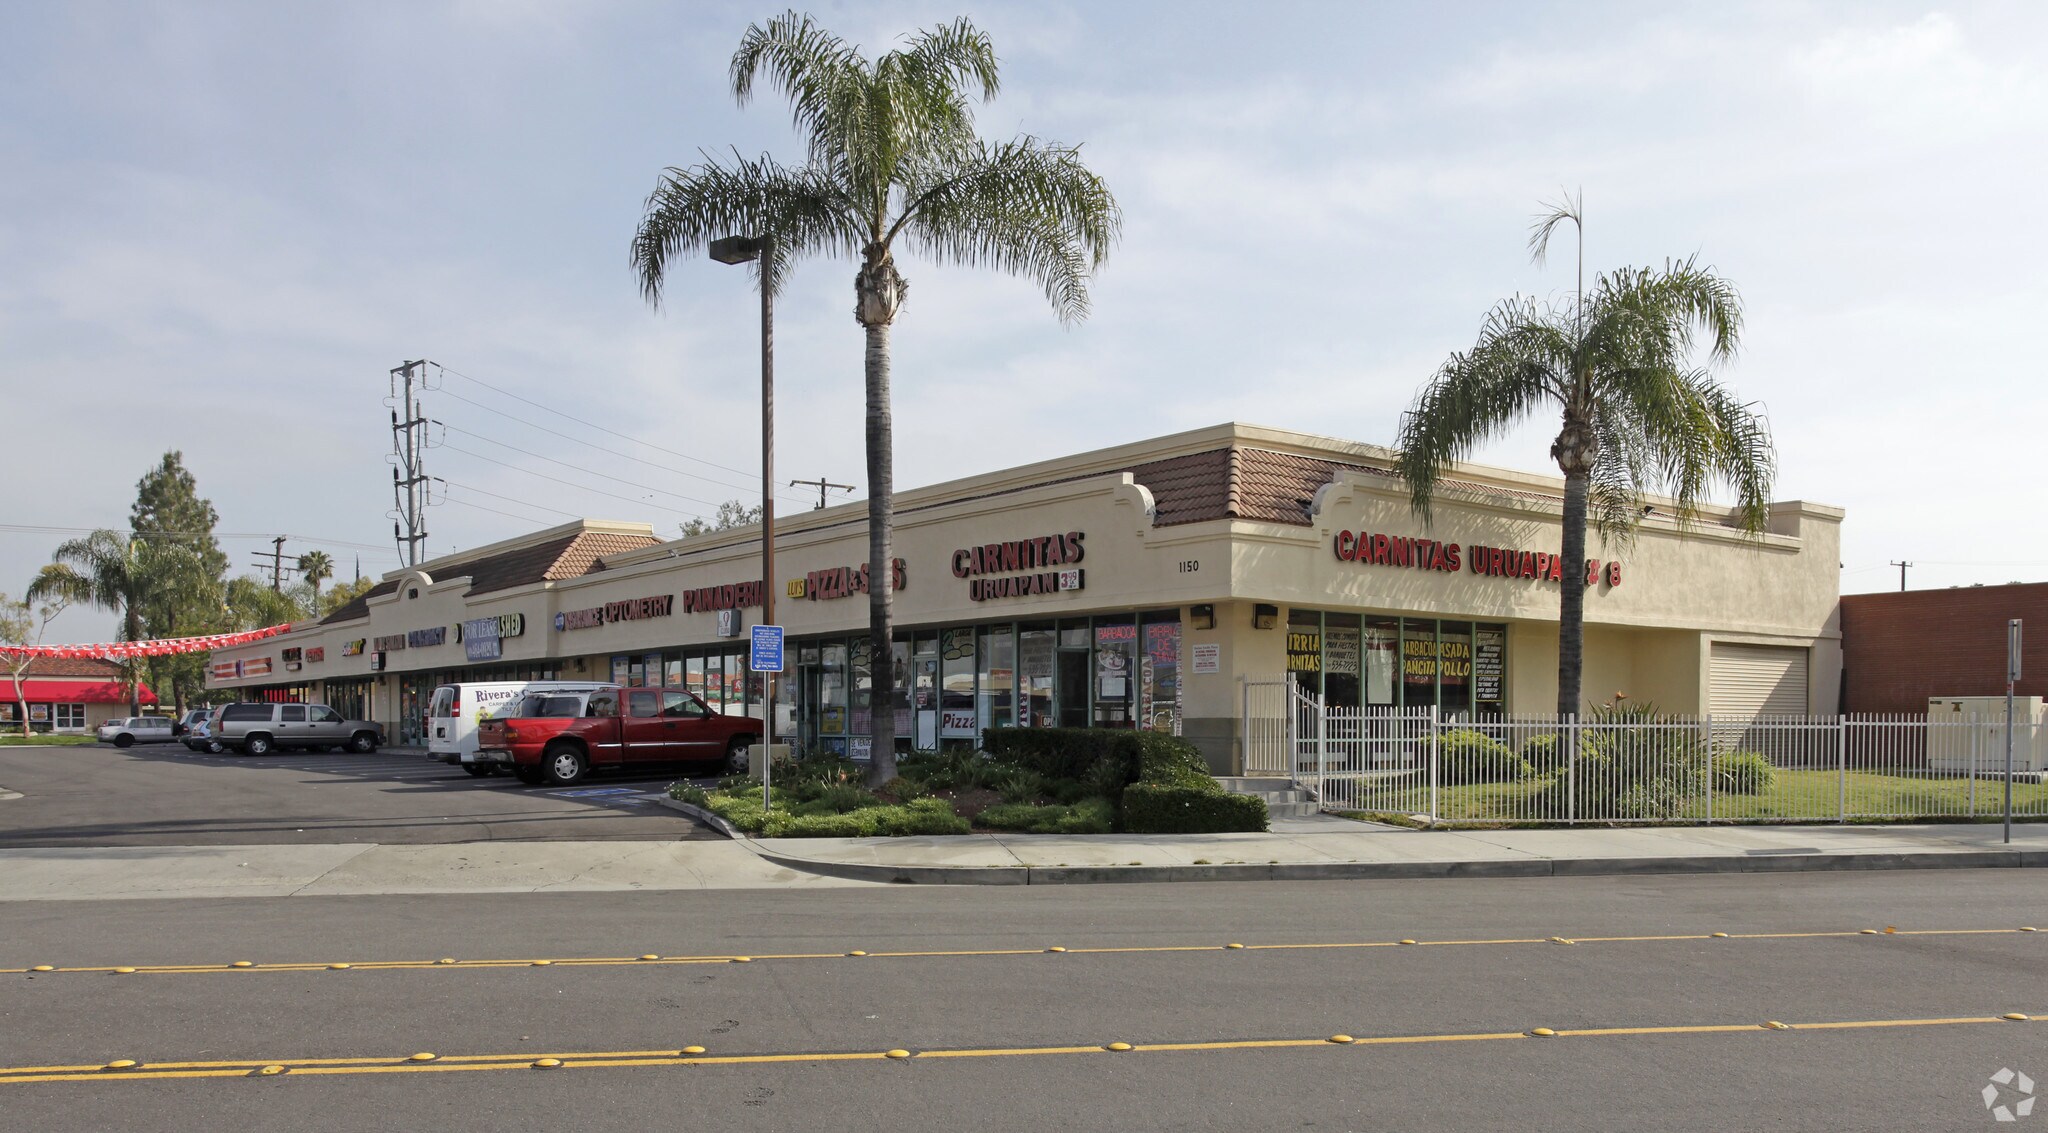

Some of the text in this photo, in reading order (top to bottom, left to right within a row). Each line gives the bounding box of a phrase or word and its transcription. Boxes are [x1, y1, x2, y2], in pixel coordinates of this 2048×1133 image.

[951, 531, 1085, 578] CARNITAS
[1334, 529, 1461, 572] CARNITAS
[1470, 545, 1563, 582] URUAPA
[1606, 560, 1621, 587] 8
[1179, 560, 1199, 573] 1150
[807, 567, 853, 601] PIZZA
[970, 572, 1059, 601] URUAPAN
[683, 581, 776, 613] PANADERI
[604, 595, 674, 623] OPTOMETRY
[479, 621, 498, 637] LEASE
[1158, 638, 1170, 651] DE
[1287, 633, 1320, 651] IRRIA
[1403, 640, 1437, 656] ARBACOA
[1440, 642, 1470, 658] ASADA
[1287, 654, 1320, 672] ARNITAS
[1403, 660, 1436, 675] PANCITA
[1440, 661, 1471, 676] POLLO
[475, 690, 519, 703] Rivera's
[1020, 675, 1029, 725] BIRRI
[1142, 657, 1154, 732] BARBACOA
[942, 713, 975, 729] Pizza
